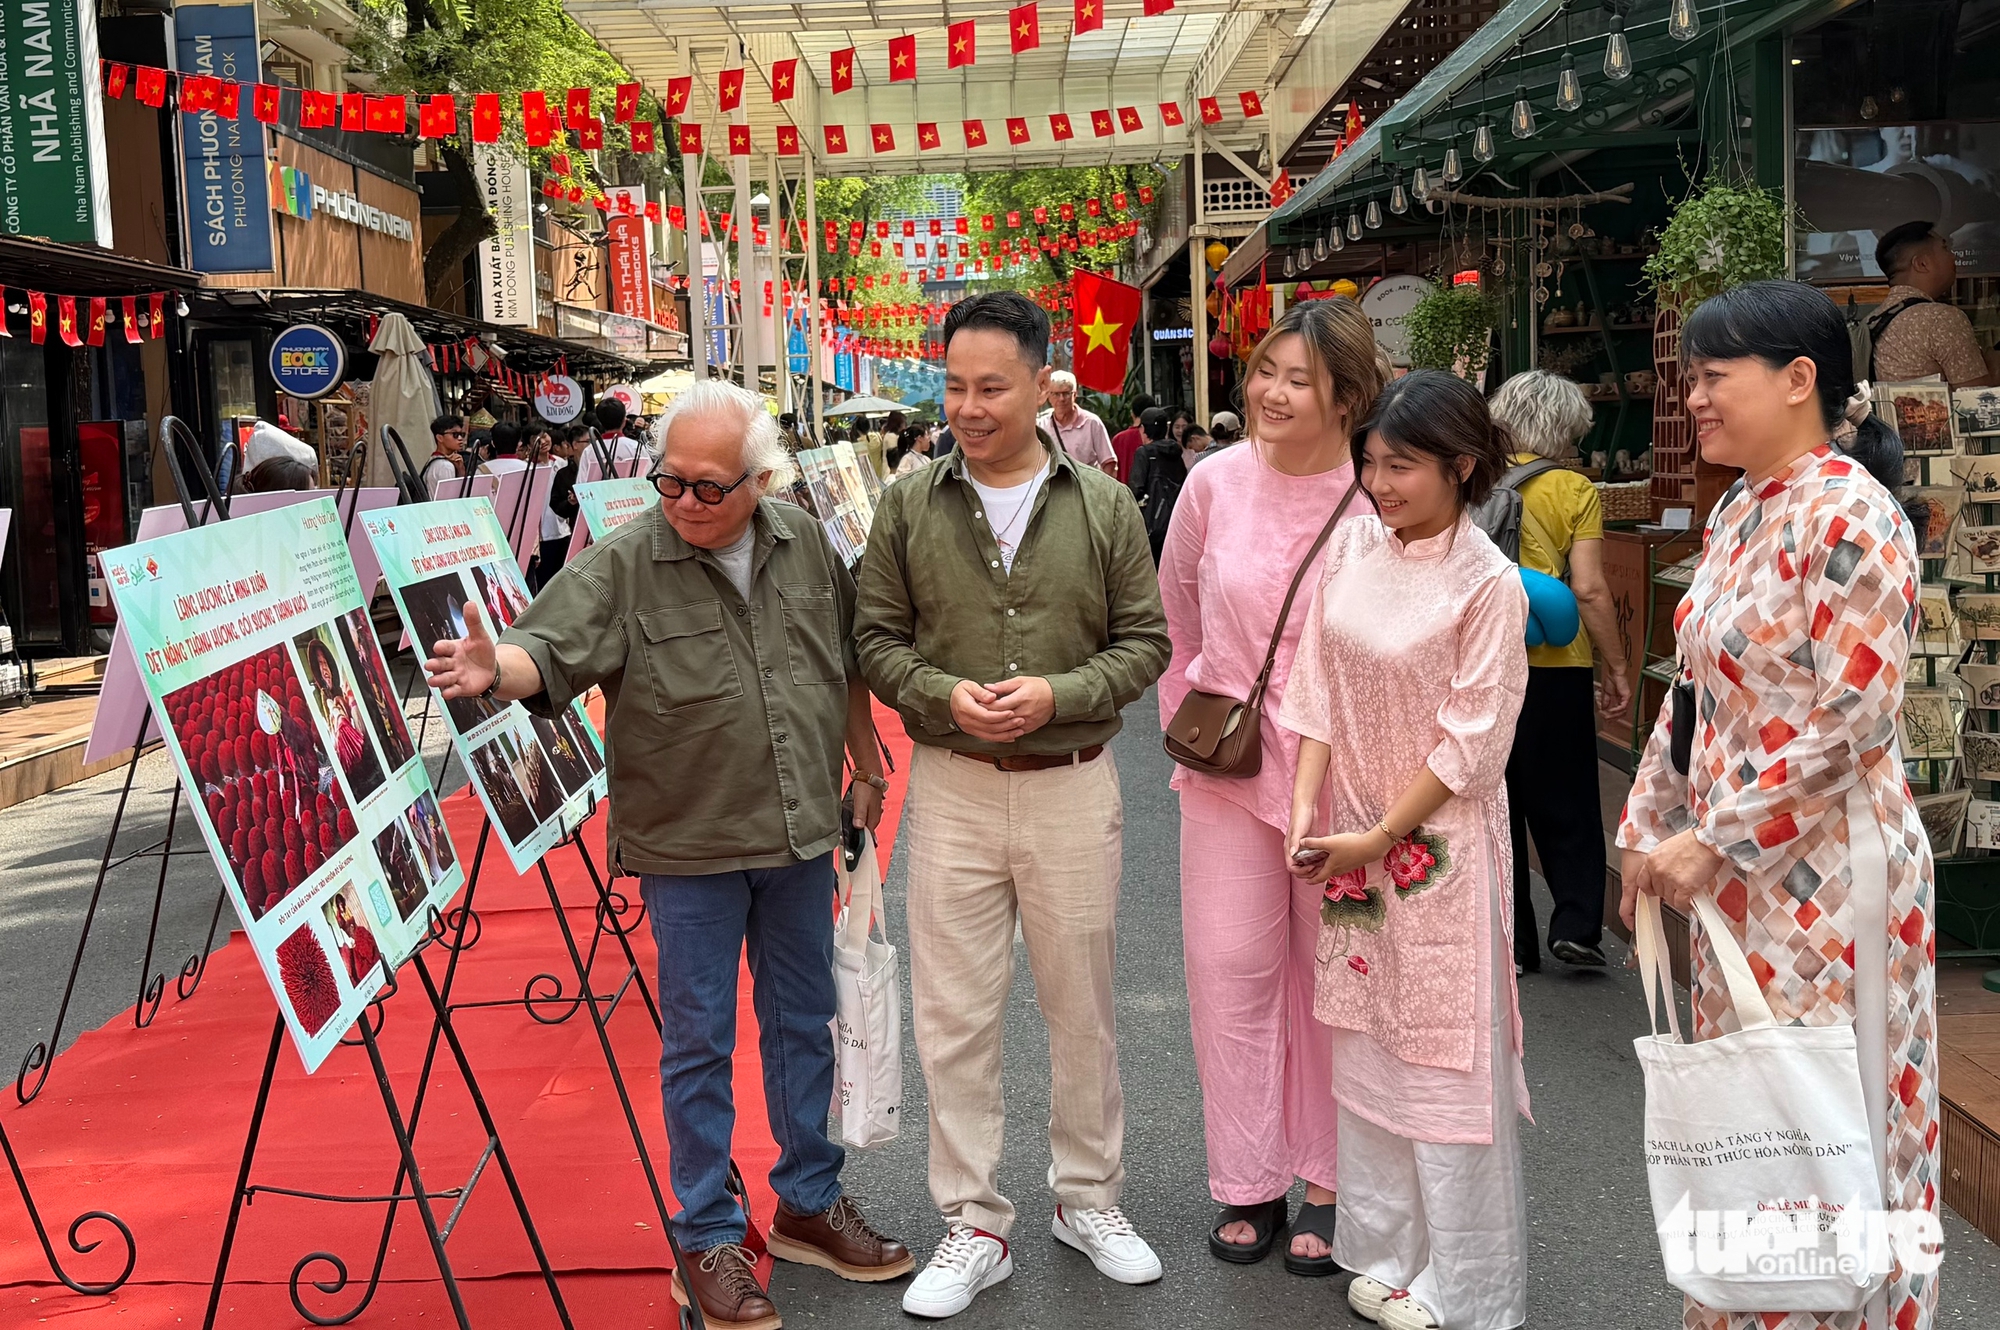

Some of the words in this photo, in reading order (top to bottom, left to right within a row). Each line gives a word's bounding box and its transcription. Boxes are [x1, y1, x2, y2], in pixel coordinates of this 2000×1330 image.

[21, 2, 54, 77] NAM
[65, 72, 78, 95] and
[19, 88, 61, 162] NHÃ
[69, 98, 83, 161] Publishing
[5, 178, 18, 193] TY
[74, 165, 86, 194] Nam
[229, 154, 247, 228] PHUONG
[5, 196, 20, 234] CÔNG
[75, 198, 88, 223] Nha
[204, 185, 227, 246] SÁCH
[379, 212, 414, 243] NAM
[616, 224, 630, 248] HÀ
[488, 256, 503, 288] XUẤT
[505, 260, 517, 296] DONG
[617, 251, 632, 288] THÁI
[491, 290, 504, 318] NHÀ
[507, 299, 518, 318] KIM
[1376, 287, 1395, 302] BOOK
[281, 352, 329, 367] BOOK
[281, 366, 330, 376] STORE
[173, 593, 199, 622] LÀNG
[145, 648, 165, 676] DỆT
[163, 636, 189, 668] NẮNG
[1692, 1156, 1713, 1168] TRI
[1753, 1145, 1782, 1159] HÓA
[1694, 1137, 1724, 1154] QUÀ
